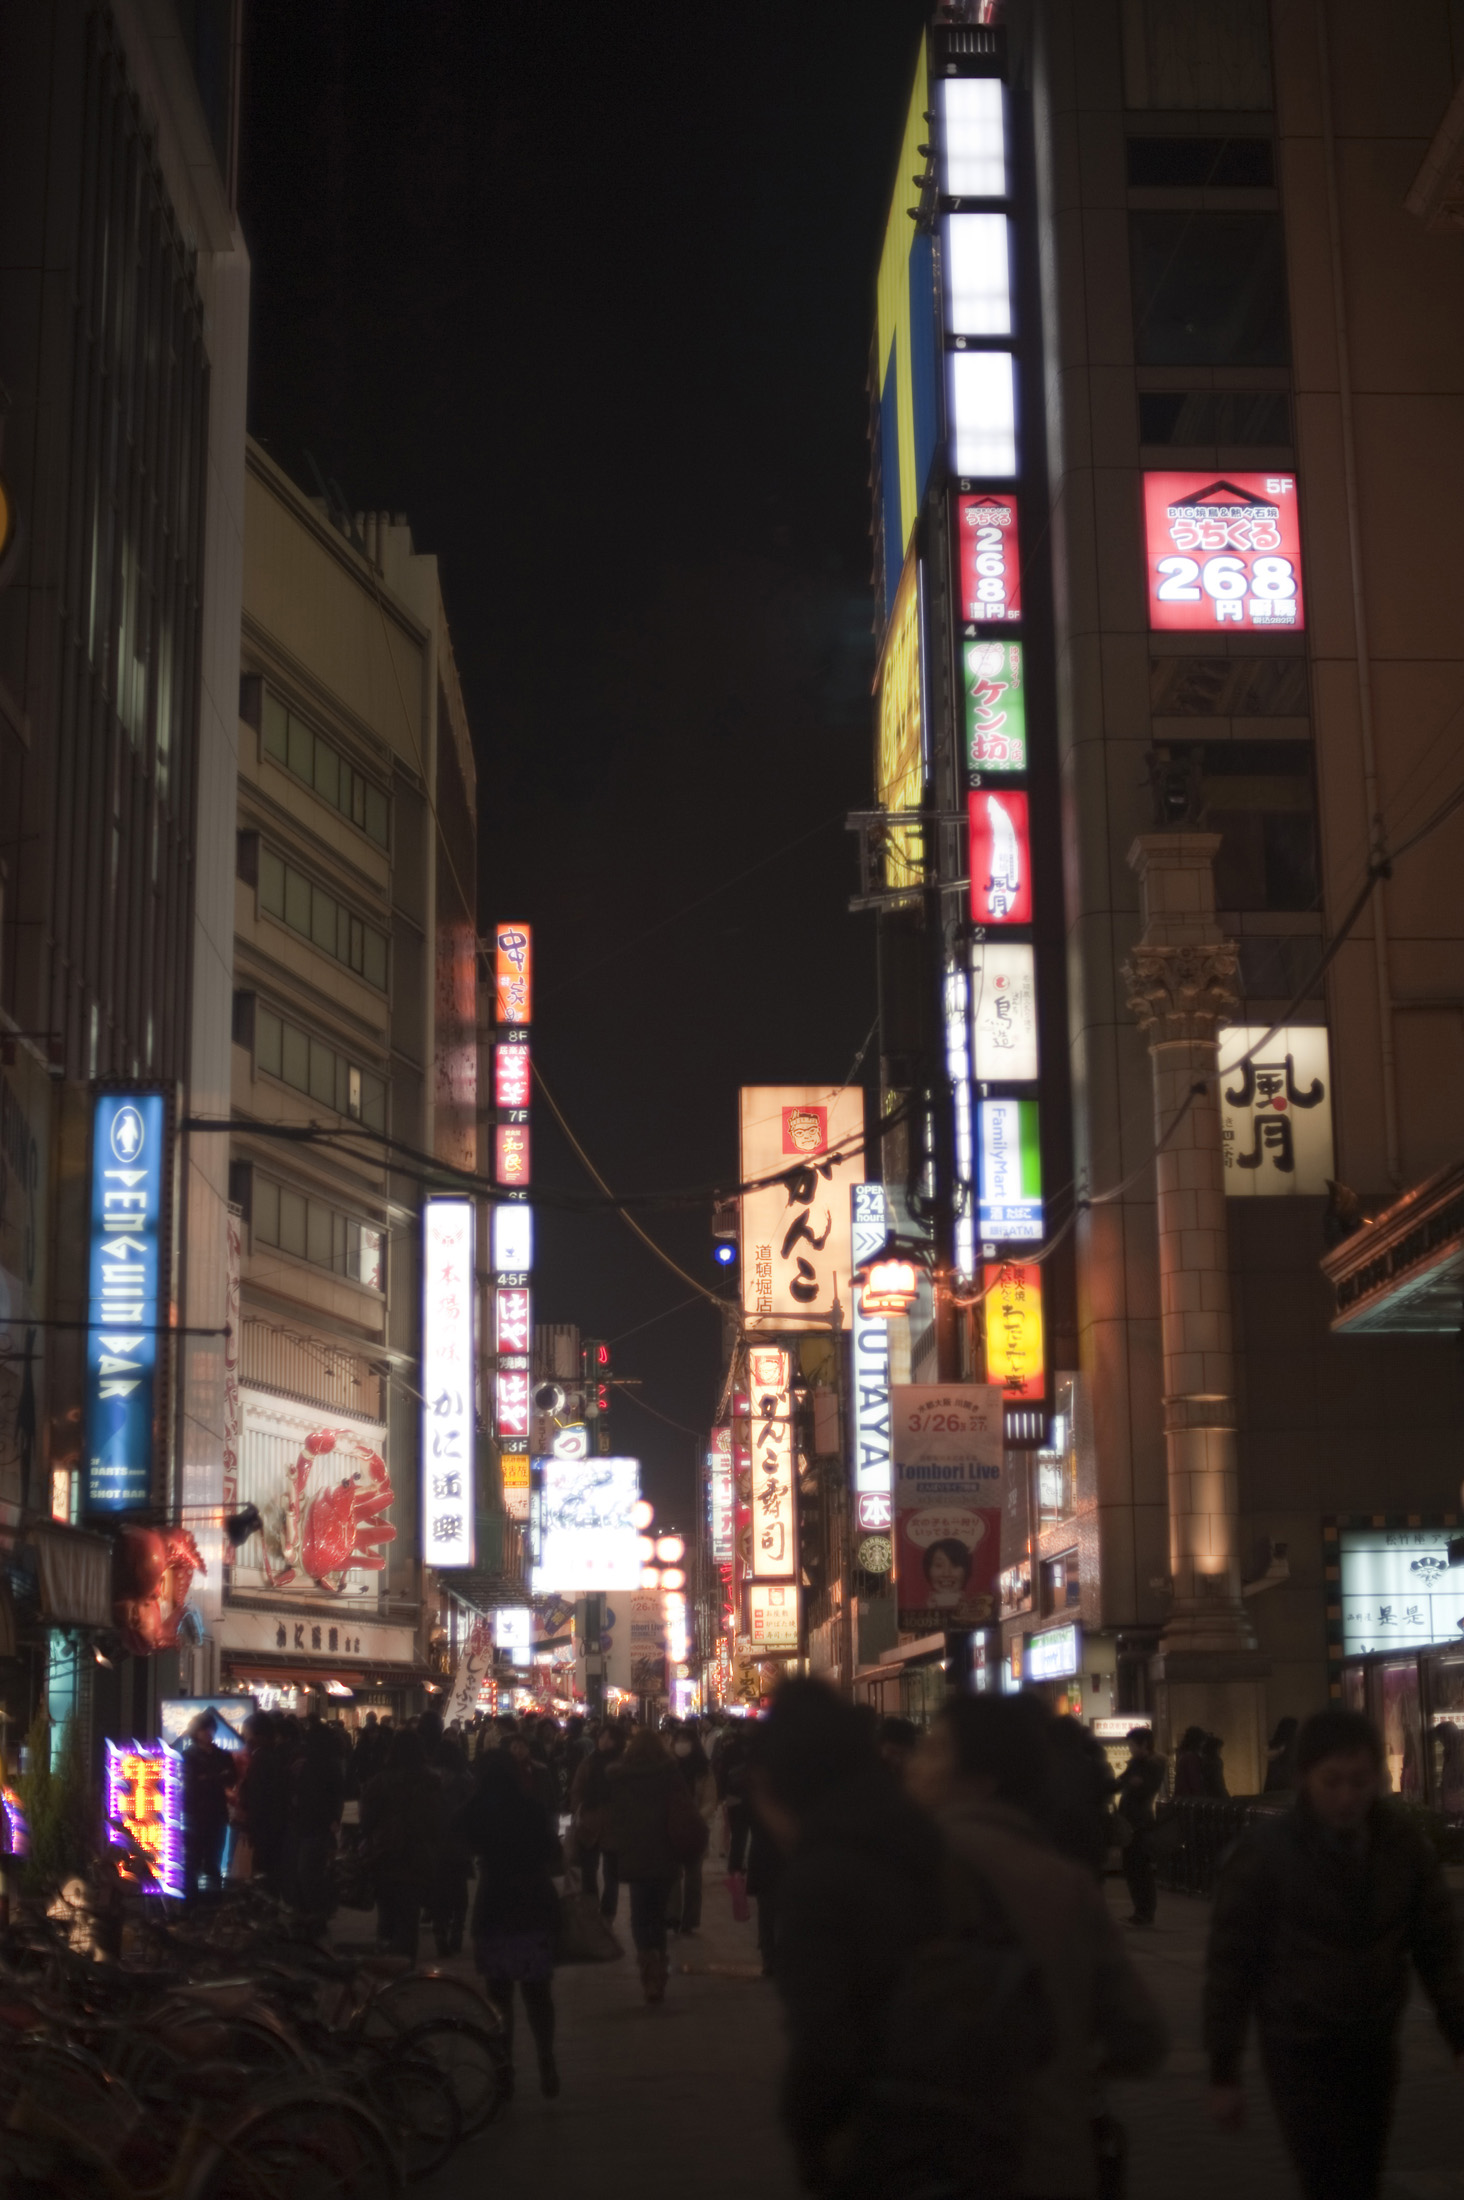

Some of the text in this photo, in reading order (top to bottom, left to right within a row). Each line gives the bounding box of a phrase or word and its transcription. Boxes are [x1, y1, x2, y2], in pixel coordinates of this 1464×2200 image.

[951, 197, 961, 210] 7
[955, 336, 967, 349] 6
[960, 478, 971, 491] 5
[1266, 478, 1293, 494] 5F
[965, 512, 1012, 526] うちくる
[1169, 518, 1282, 551] うちくる
[975, 526, 1006, 603] 268
[1156, 554, 1299, 602] 268
[1007, 609, 1021, 620] 5F
[1215, 599, 1244, 622] 円
[964, 623, 977, 637] 4
[970, 677, 1010, 762] ケン坊
[970, 772, 982, 787] 3
[984, 873, 1021, 916] 風月
[974, 926, 986, 941] 2
[508, 1030, 528, 1043] 8F
[980, 1083, 988, 1098] 1
[508, 1109, 529, 1122] 7F
[1224, 1052, 1325, 1173] 風月
[989, 1107, 1009, 1198] FamilyMart
[856, 1194, 885, 1215] 24
[1006, 1207, 1033, 1220] たばこ
[780, 1151, 843, 1304] がんこ
[856, 1214, 885, 1223] hours
[982, 1242, 997, 1258] B
[97, 1169, 149, 1400] PENGUIN BAR
[755, 1244, 773, 1313] 道頓堀店
[499, 1293, 528, 1349] はや
[499, 1375, 528, 1431] はや
[908, 1413, 960, 1433] 3/26
[508, 1439, 528, 1452] 3F
[895, 1461, 1001, 1481] Tombori Live
[90, 1490, 147, 1499] SHOT BAR
[862, 1496, 891, 1526] 本
